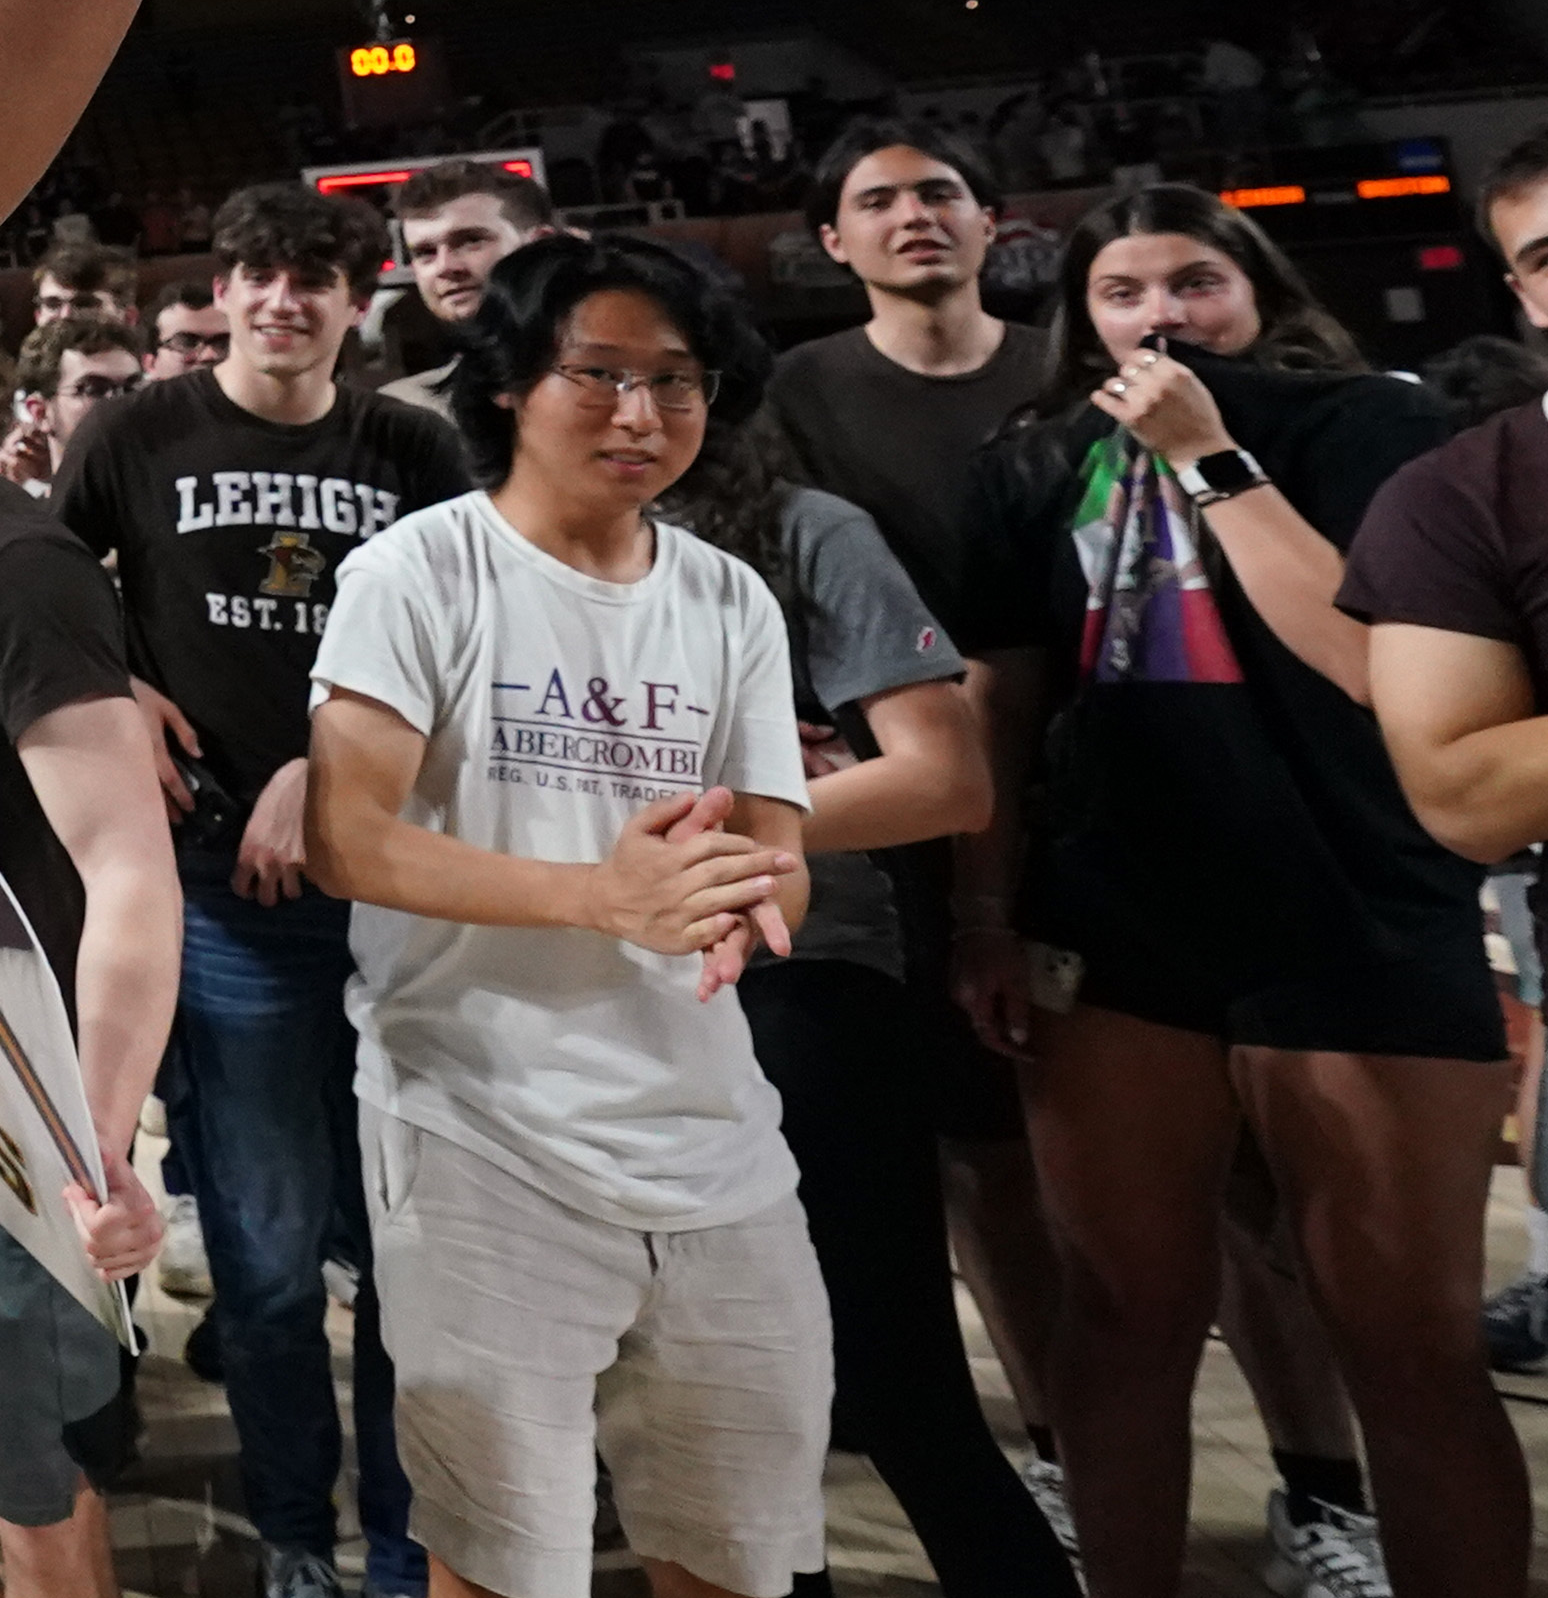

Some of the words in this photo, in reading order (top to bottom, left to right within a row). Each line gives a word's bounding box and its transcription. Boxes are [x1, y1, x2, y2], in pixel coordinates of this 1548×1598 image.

[175, 471, 401, 540] LEHIGH
[206, 592, 283, 631] EST.
[294, 602, 330, 636] 18
[489, 725, 700, 777] ABERCROMBI
